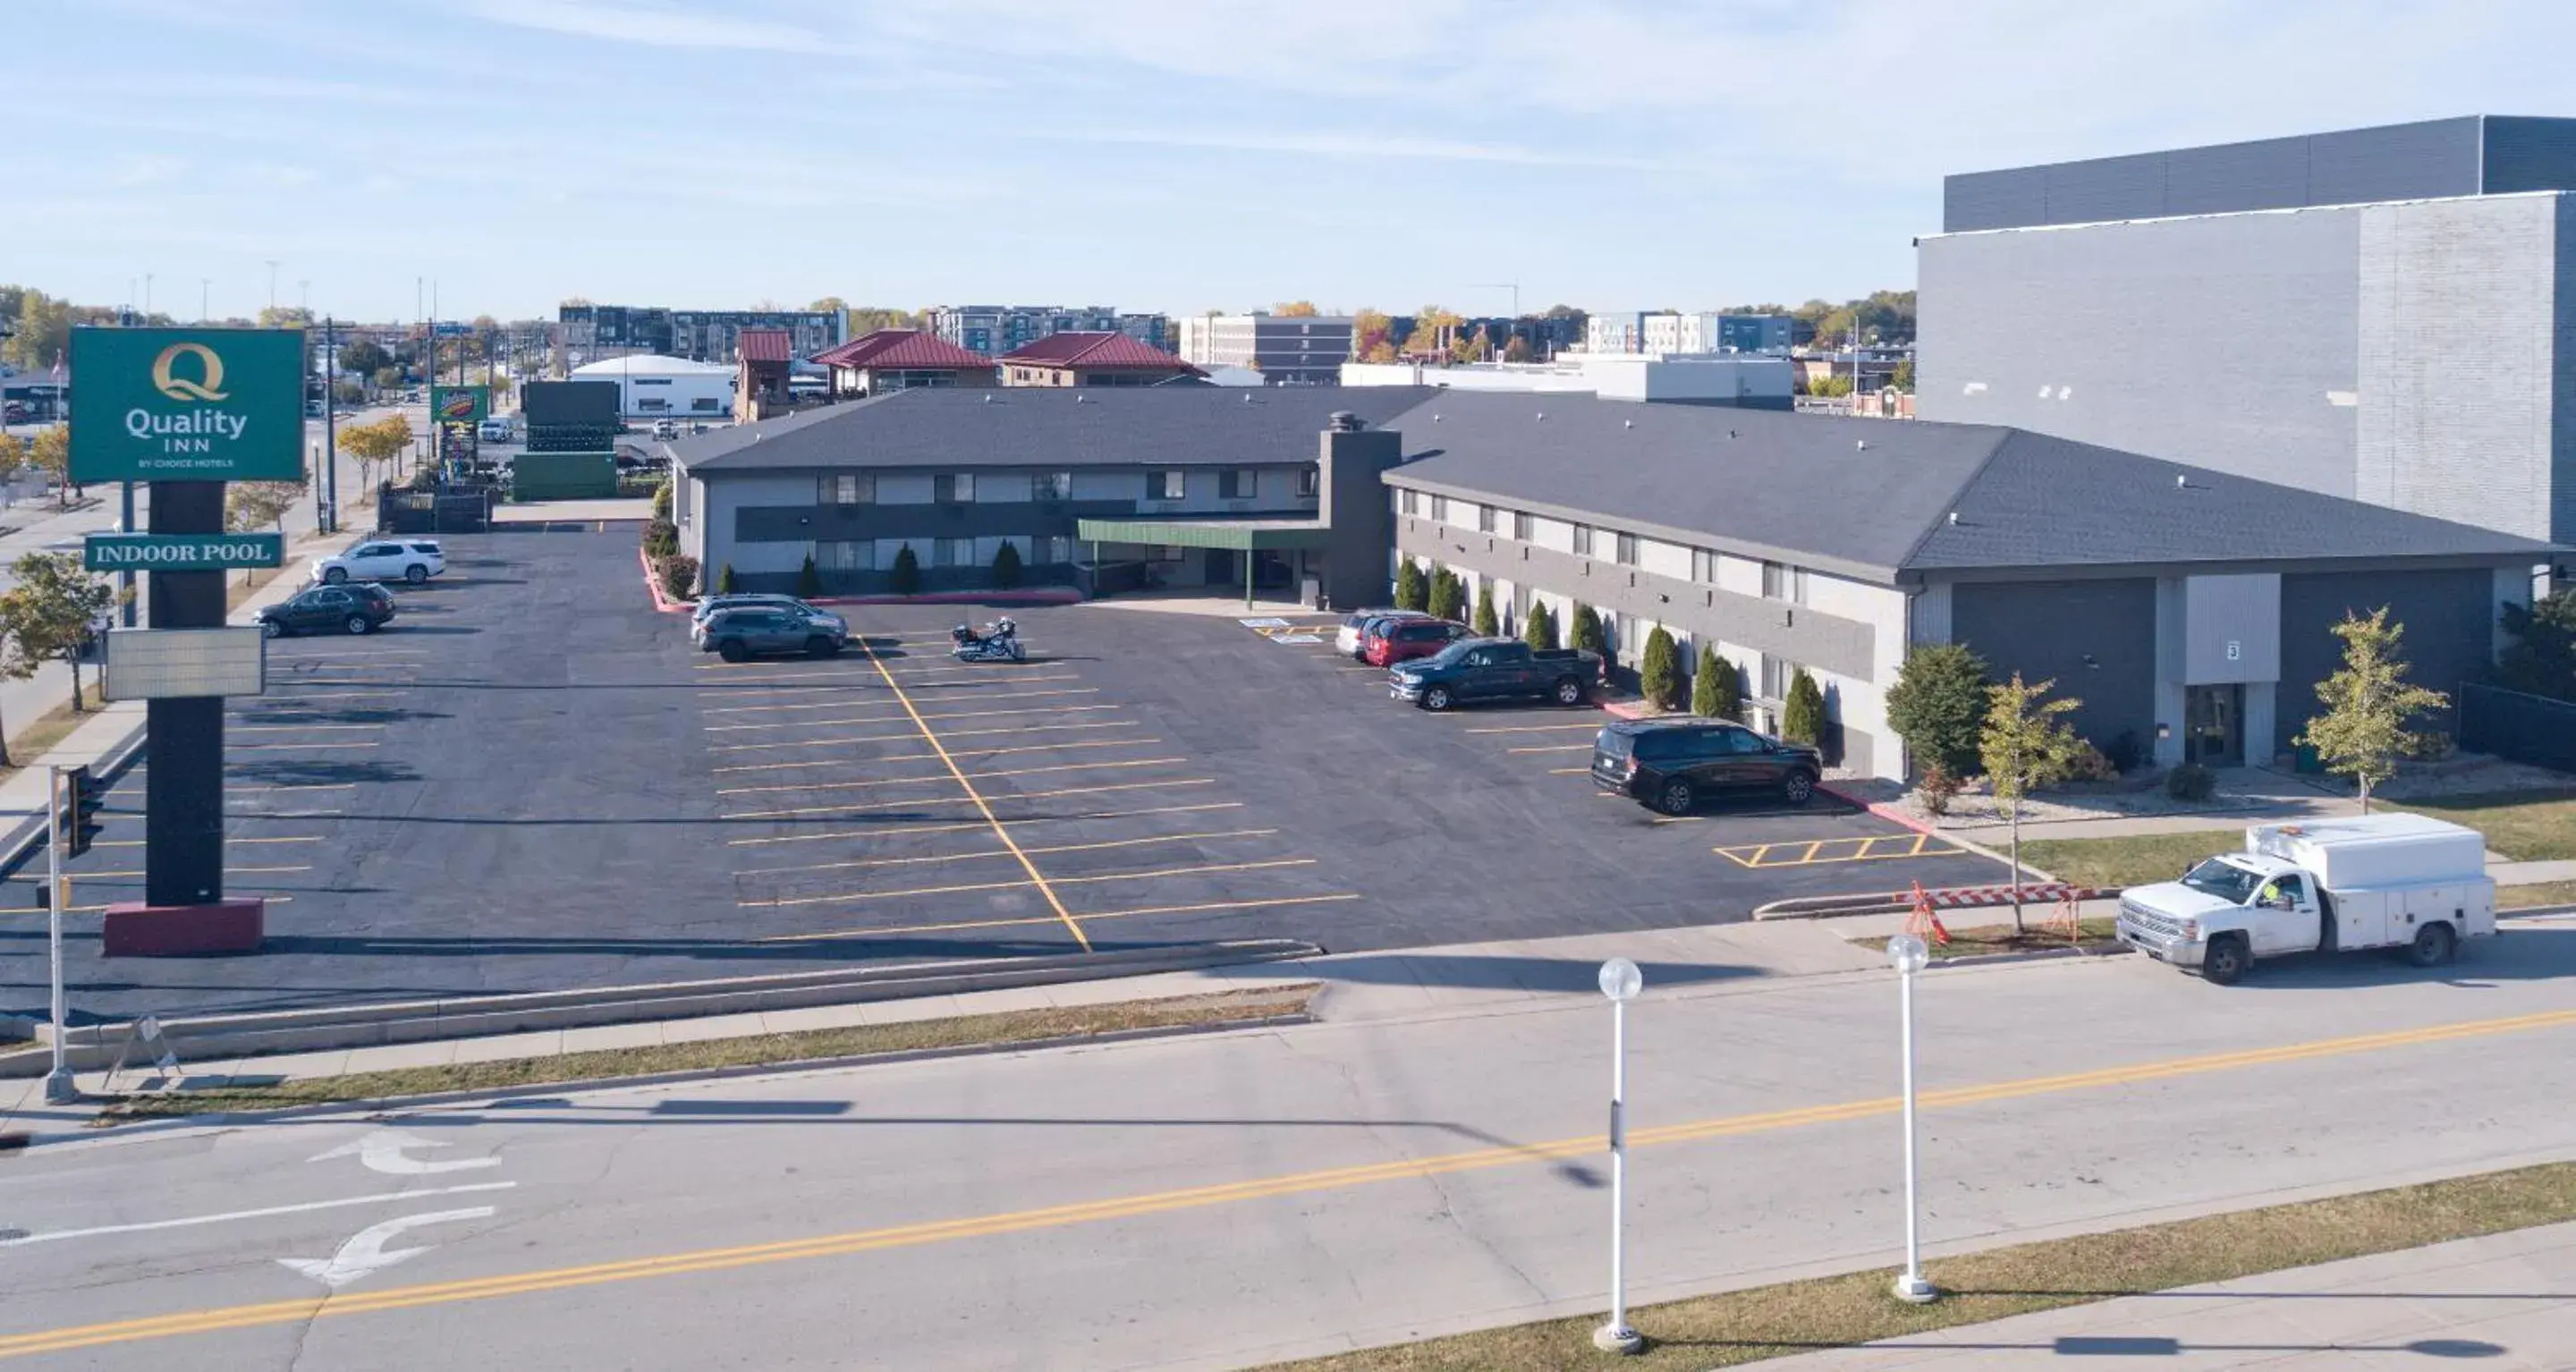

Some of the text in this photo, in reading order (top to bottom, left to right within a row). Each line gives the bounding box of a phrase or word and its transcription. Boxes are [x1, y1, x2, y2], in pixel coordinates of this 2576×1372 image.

[153, 343, 229, 401] Q
[126, 408, 248, 440] Quality
[164, 438, 210, 453] INN
[138, 459, 233, 468] BY CHOICE HOTELS
[96, 543, 272, 563] INDOOR POOL
